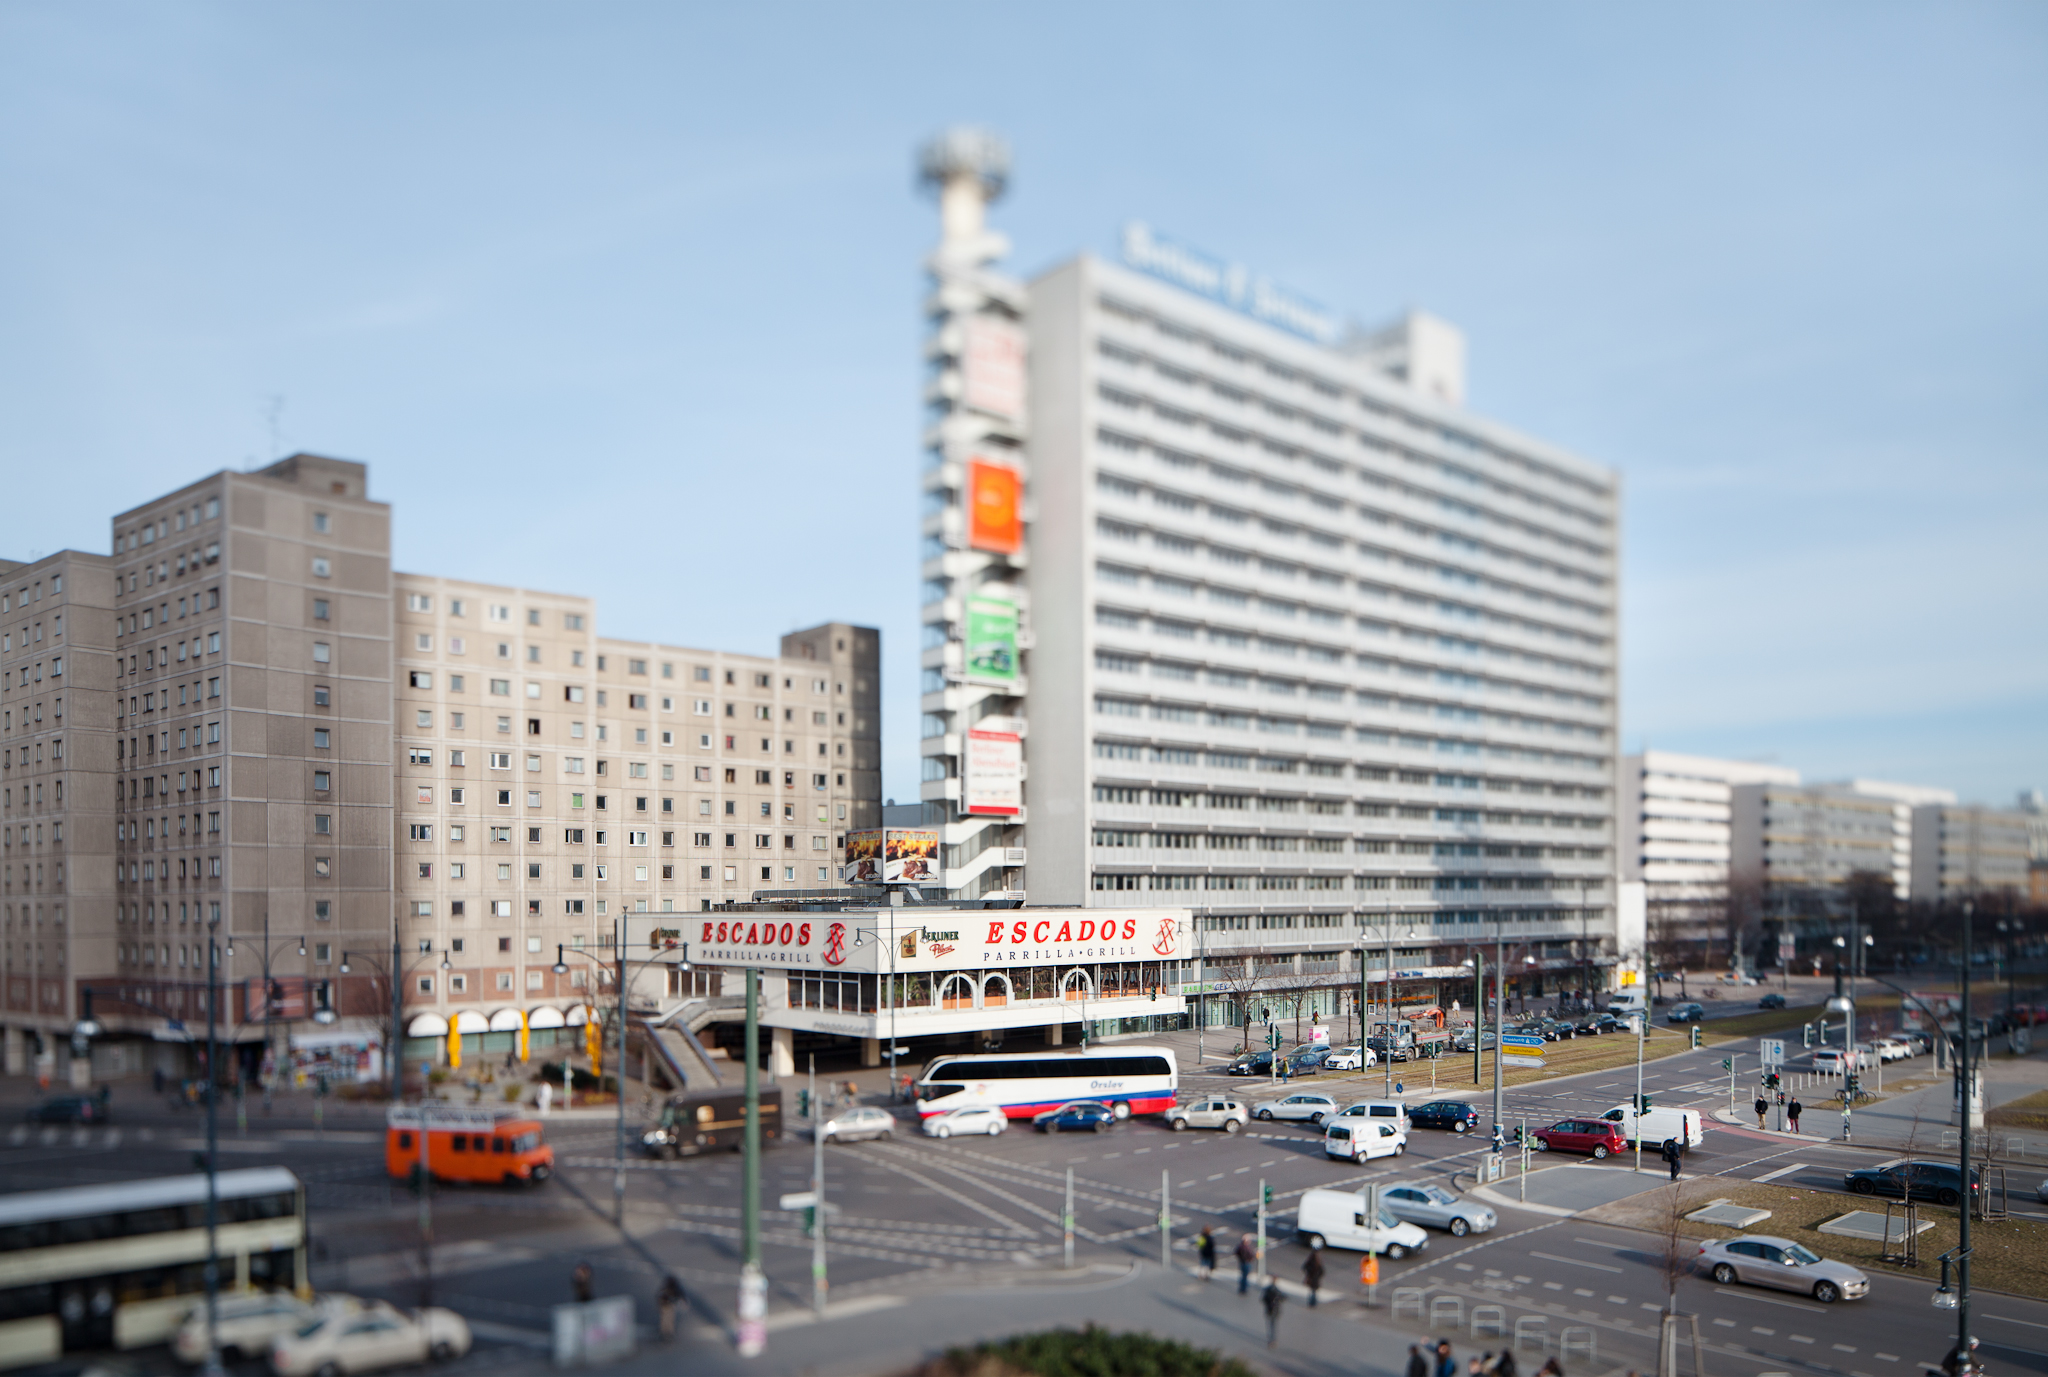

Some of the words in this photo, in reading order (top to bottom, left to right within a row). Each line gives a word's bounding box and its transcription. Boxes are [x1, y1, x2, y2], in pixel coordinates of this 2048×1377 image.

[887, 832, 907, 841] BEST
[908, 832, 936, 841] STEAKS
[701, 922, 811, 946] ESCADOS
[985, 919, 1136, 944] ESCADOS
